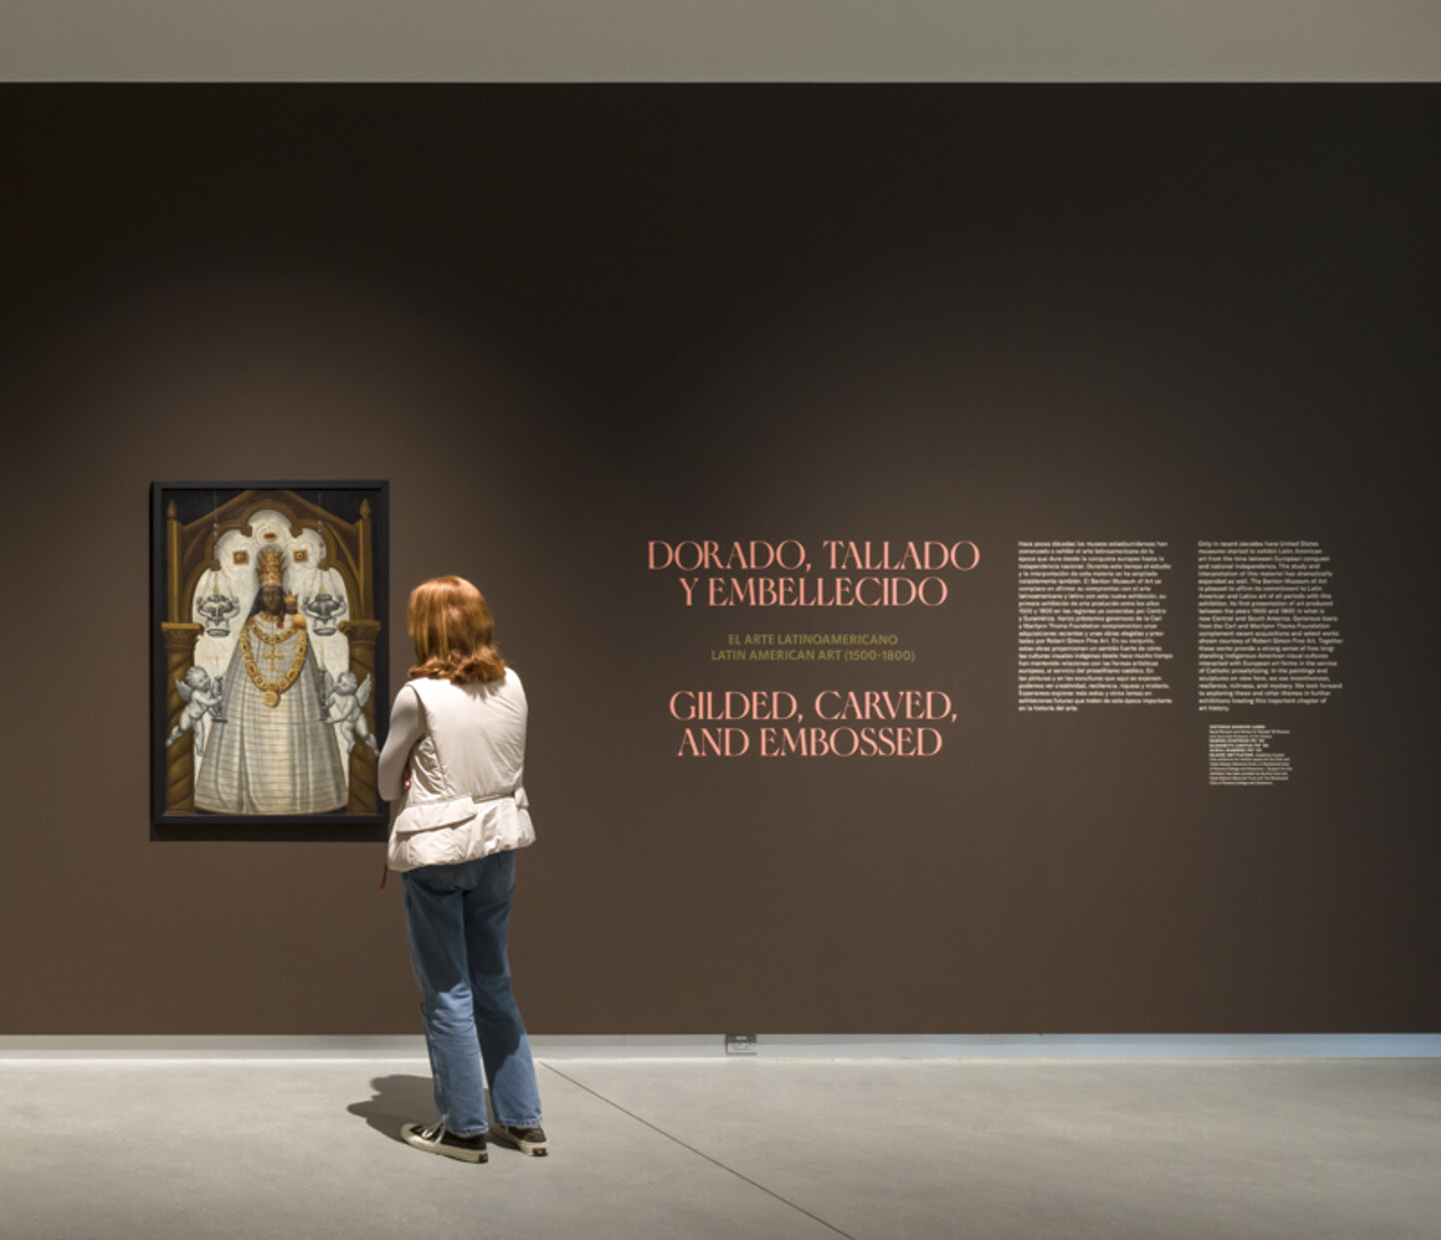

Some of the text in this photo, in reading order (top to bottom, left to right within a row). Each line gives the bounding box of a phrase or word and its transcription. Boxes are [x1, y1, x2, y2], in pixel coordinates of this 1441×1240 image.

[649, 540, 980, 572] DORADO, TALLADO
[680, 578, 948, 606] Y EMBELLECIDO
[728, 634, 898, 645] EL ARTE LATINOAMERICANO
[711, 649, 915, 661] LATIN AMERICAN ART (1500-1800)
[669, 691, 957, 722] GILDED, CARVED,
[678, 728, 943, 756] AND EMBOSSED
